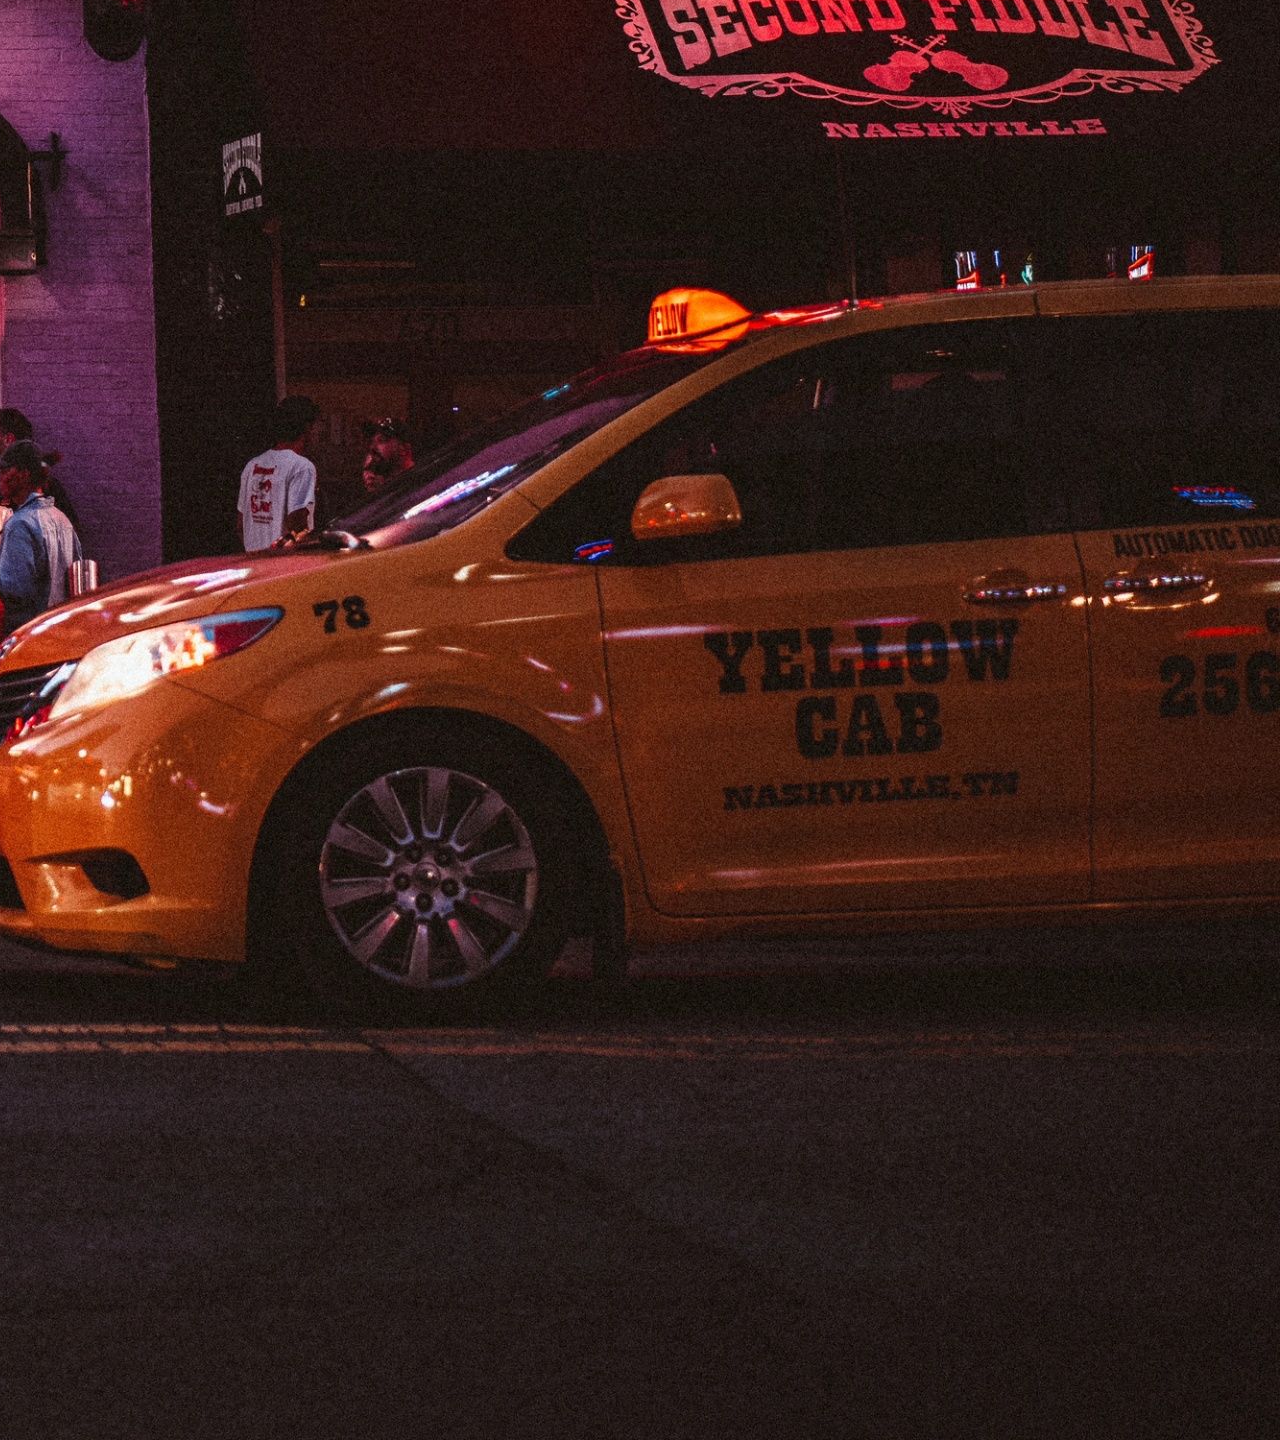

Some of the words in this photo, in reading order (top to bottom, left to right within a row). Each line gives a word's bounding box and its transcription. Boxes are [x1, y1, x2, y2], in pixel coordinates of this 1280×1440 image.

[821, 117, 1108, 140] NASHVILLE
[1113, 526, 1237, 558] AUTOMATIC
[312, 595, 371, 634] 78
[704, 619, 1019, 694] YELLOW
[795, 691, 943, 760] CAB
